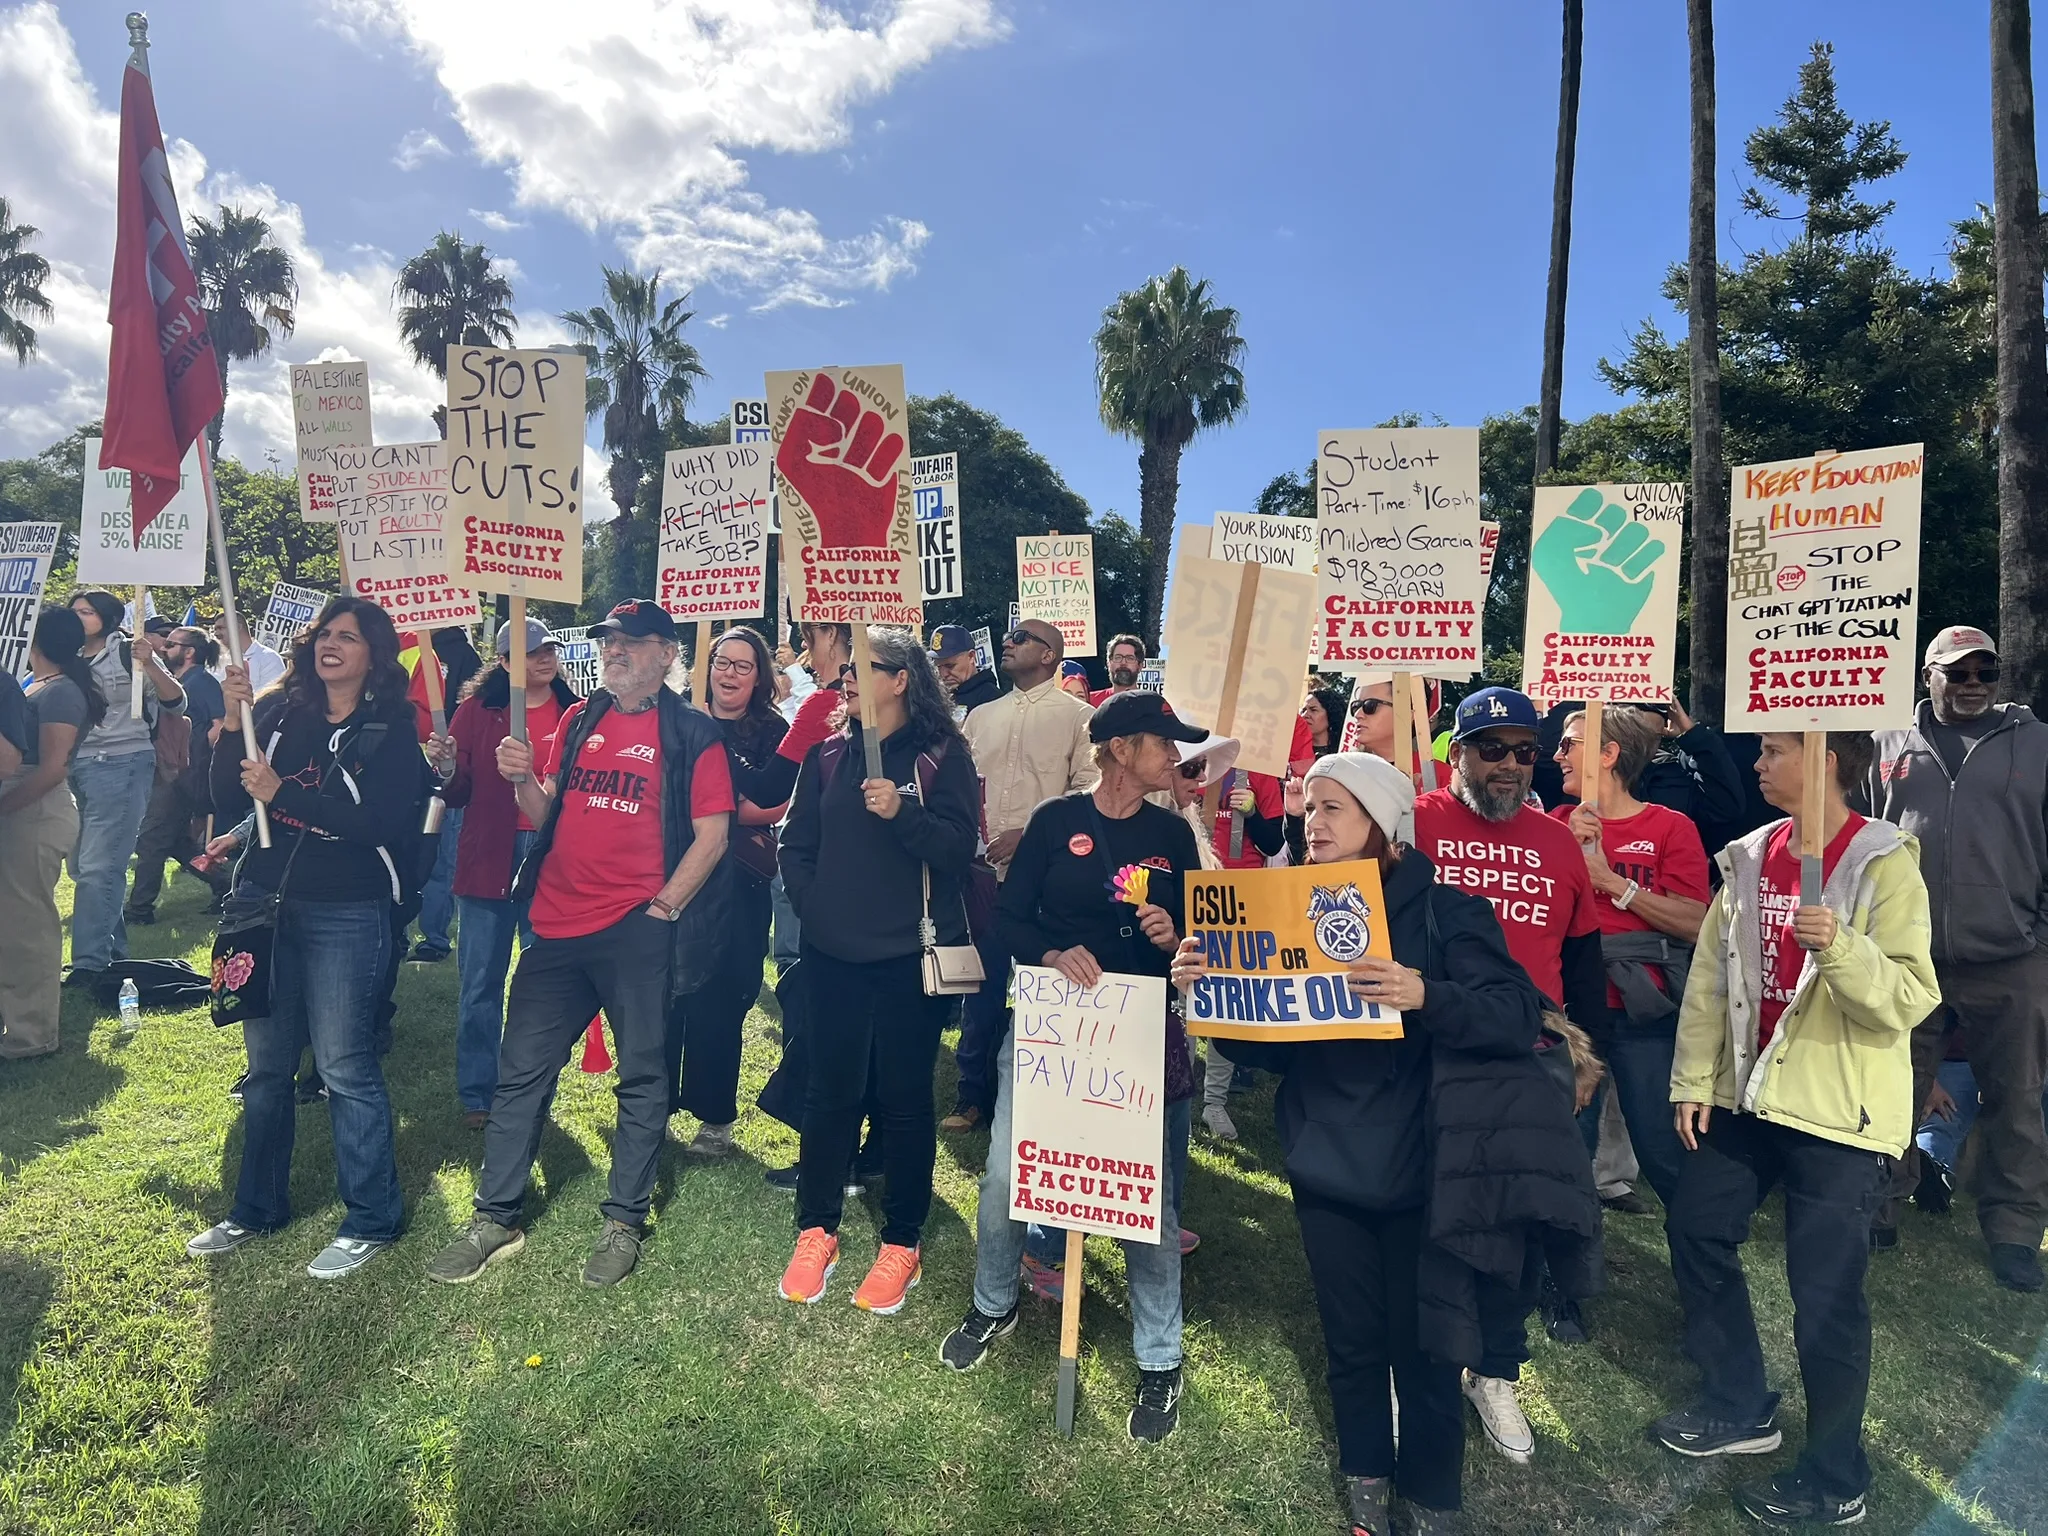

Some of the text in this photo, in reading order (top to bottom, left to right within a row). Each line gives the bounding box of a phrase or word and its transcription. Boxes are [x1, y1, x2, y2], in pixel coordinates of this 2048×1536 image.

[294, 369, 363, 389] PALESTINE
[460, 350, 559, 403] STOP
[792, 372, 810, 396] ON
[295, 394, 363, 411] TO MEXICO
[842, 370, 899, 421] UNION
[298, 421, 353, 436] ALL WALLS
[450, 404, 546, 449] THE
[772, 395, 796, 444] RUNS
[301, 447, 329, 462] MUST
[327, 445, 437, 471] YOU CANT
[672, 448, 759, 479] WHY DID
[1323, 440, 1439, 487] Student
[106, 472, 131, 488] WE
[331, 476, 358, 494] PUT
[452, 455, 579, 514] CUTS!
[685, 477, 733, 496] YOU
[924, 472, 954, 484] LABOR
[1745, 454, 1922, 500] KEEP EDUCATION
[1321, 487, 1411, 515] Part-Time:
[1624, 483, 1685, 503] UNION
[337, 495, 399, 517] FIRST
[400, 497, 416, 511] IF
[664, 488, 757, 535] REALLY
[914, 490, 954, 520] UP OR
[1634, 503, 1684, 525] POWER
[1769, 497, 1884, 531] HUMAN
[101, 512, 190, 530] DESVE A
[340, 513, 443, 536] PUT FACULTY
[464, 515, 565, 542] CALIFORNIA
[795, 506, 818, 545] THE
[1220, 516, 1312, 543] YOUR BUSINESS
[20, 525, 56, 543] UNFAIR
[100, 532, 129, 549] 3%
[661, 521, 761, 553] TAKE THIS
[917, 520, 954, 558] IKE
[1320, 526, 1401, 552] Mildred
[18, 543, 51, 553] TO LABOR
[352, 537, 443, 560] LAST!!!
[465, 536, 563, 563] FACULTY
[696, 540, 760, 566] JOB?
[801, 545, 901, 564] CALIFORNIA
[1025, 541, 1090, 557] NO CUTS
[1223, 544, 1294, 566] DECISION
[1807, 539, 1901, 567] STOP
[11, 561, 33, 594] UP
[30, 583, 41, 595] OR
[464, 556, 563, 581] ASSOCIATION
[662, 566, 761, 582] CALIFORNIA
[804, 566, 900, 585] FACULTY
[922, 556, 956, 595] UT
[1022, 561, 1083, 576] NO ICE
[1327, 555, 1444, 585] $983,000
[1778, 572, 1803, 582] STOP
[275, 583, 325, 603] CSU UNFAIR
[355, 573, 449, 594] CALIFORN
[661, 581, 760, 599] FACULTY
[1021, 579, 1090, 597] NO TPM
[1361, 581, 1444, 600] SALARY
[1817, 574, 1872, 591] THE
[359, 588, 470, 608] ACULTY
[806, 587, 903, 605] ASSOCIATION
[1022, 598, 1089, 609] LIBERATE CSU
[1325, 595, 1475, 615] CALIFORNIA
[0, 598, 35, 637] IKE
[272, 598, 312, 620] PAY UP
[390, 605, 476, 624] SOCIATION
[661, 600, 760, 615] ASSOCIATION
[801, 604, 922, 624] PROTECT WORKERS
[1035, 609, 1091, 619] HANDS OFF
[1742, 601, 1795, 620] CHAT
[1326, 618, 1473, 637] FACULTY
[1755, 618, 1901, 640] OF THE CSU
[574, 643, 589, 659] UP
[1323, 640, 1476, 660] ASSOCIATION
[1544, 633, 1655, 649] CALIFORNIA
[1544, 650, 1652, 667] FACULTY
[1749, 646, 1889, 668] CALIFORNIA
[561, 660, 597, 680] RIKE
[1148, 671, 1158, 681] UP
[1541, 669, 1651, 684] ASSOCIATION
[1749, 667, 1886, 691] FACULTY
[1528, 683, 1671, 701] FIGHTS BACK
[1747, 693, 1885, 712] ASSOCIATION
[1488, 696, 1508, 717] LA
[631, 744, 655, 760] CFA
[568, 766, 648, 800] BERATE
[587, 796, 639, 814] THE CSU
[1437, 838, 1542, 869] RIGHTS
[1630, 840, 1654, 852] CFA
[1151, 856, 1171, 870] CFA
[1434, 864, 1556, 898] RESPECT
[1192, 885, 1246, 925] CSU:
[1490, 897, 1550, 927] TICE
[1237, 931, 1277, 970] UP
[1281, 948, 1309, 970] OR
[1018, 970, 1139, 1014] RESPECT
[1193, 976, 1300, 1022] STRIKE
[1025, 1013, 1062, 1045] US
[1016, 1048, 1076, 1097] PAY
[1017, 1140, 1156, 1180] CALIFORNIA
[1017, 1164, 1154, 1205] FACULTY
[1014, 1188, 1155, 1230] ASSOCIATION
